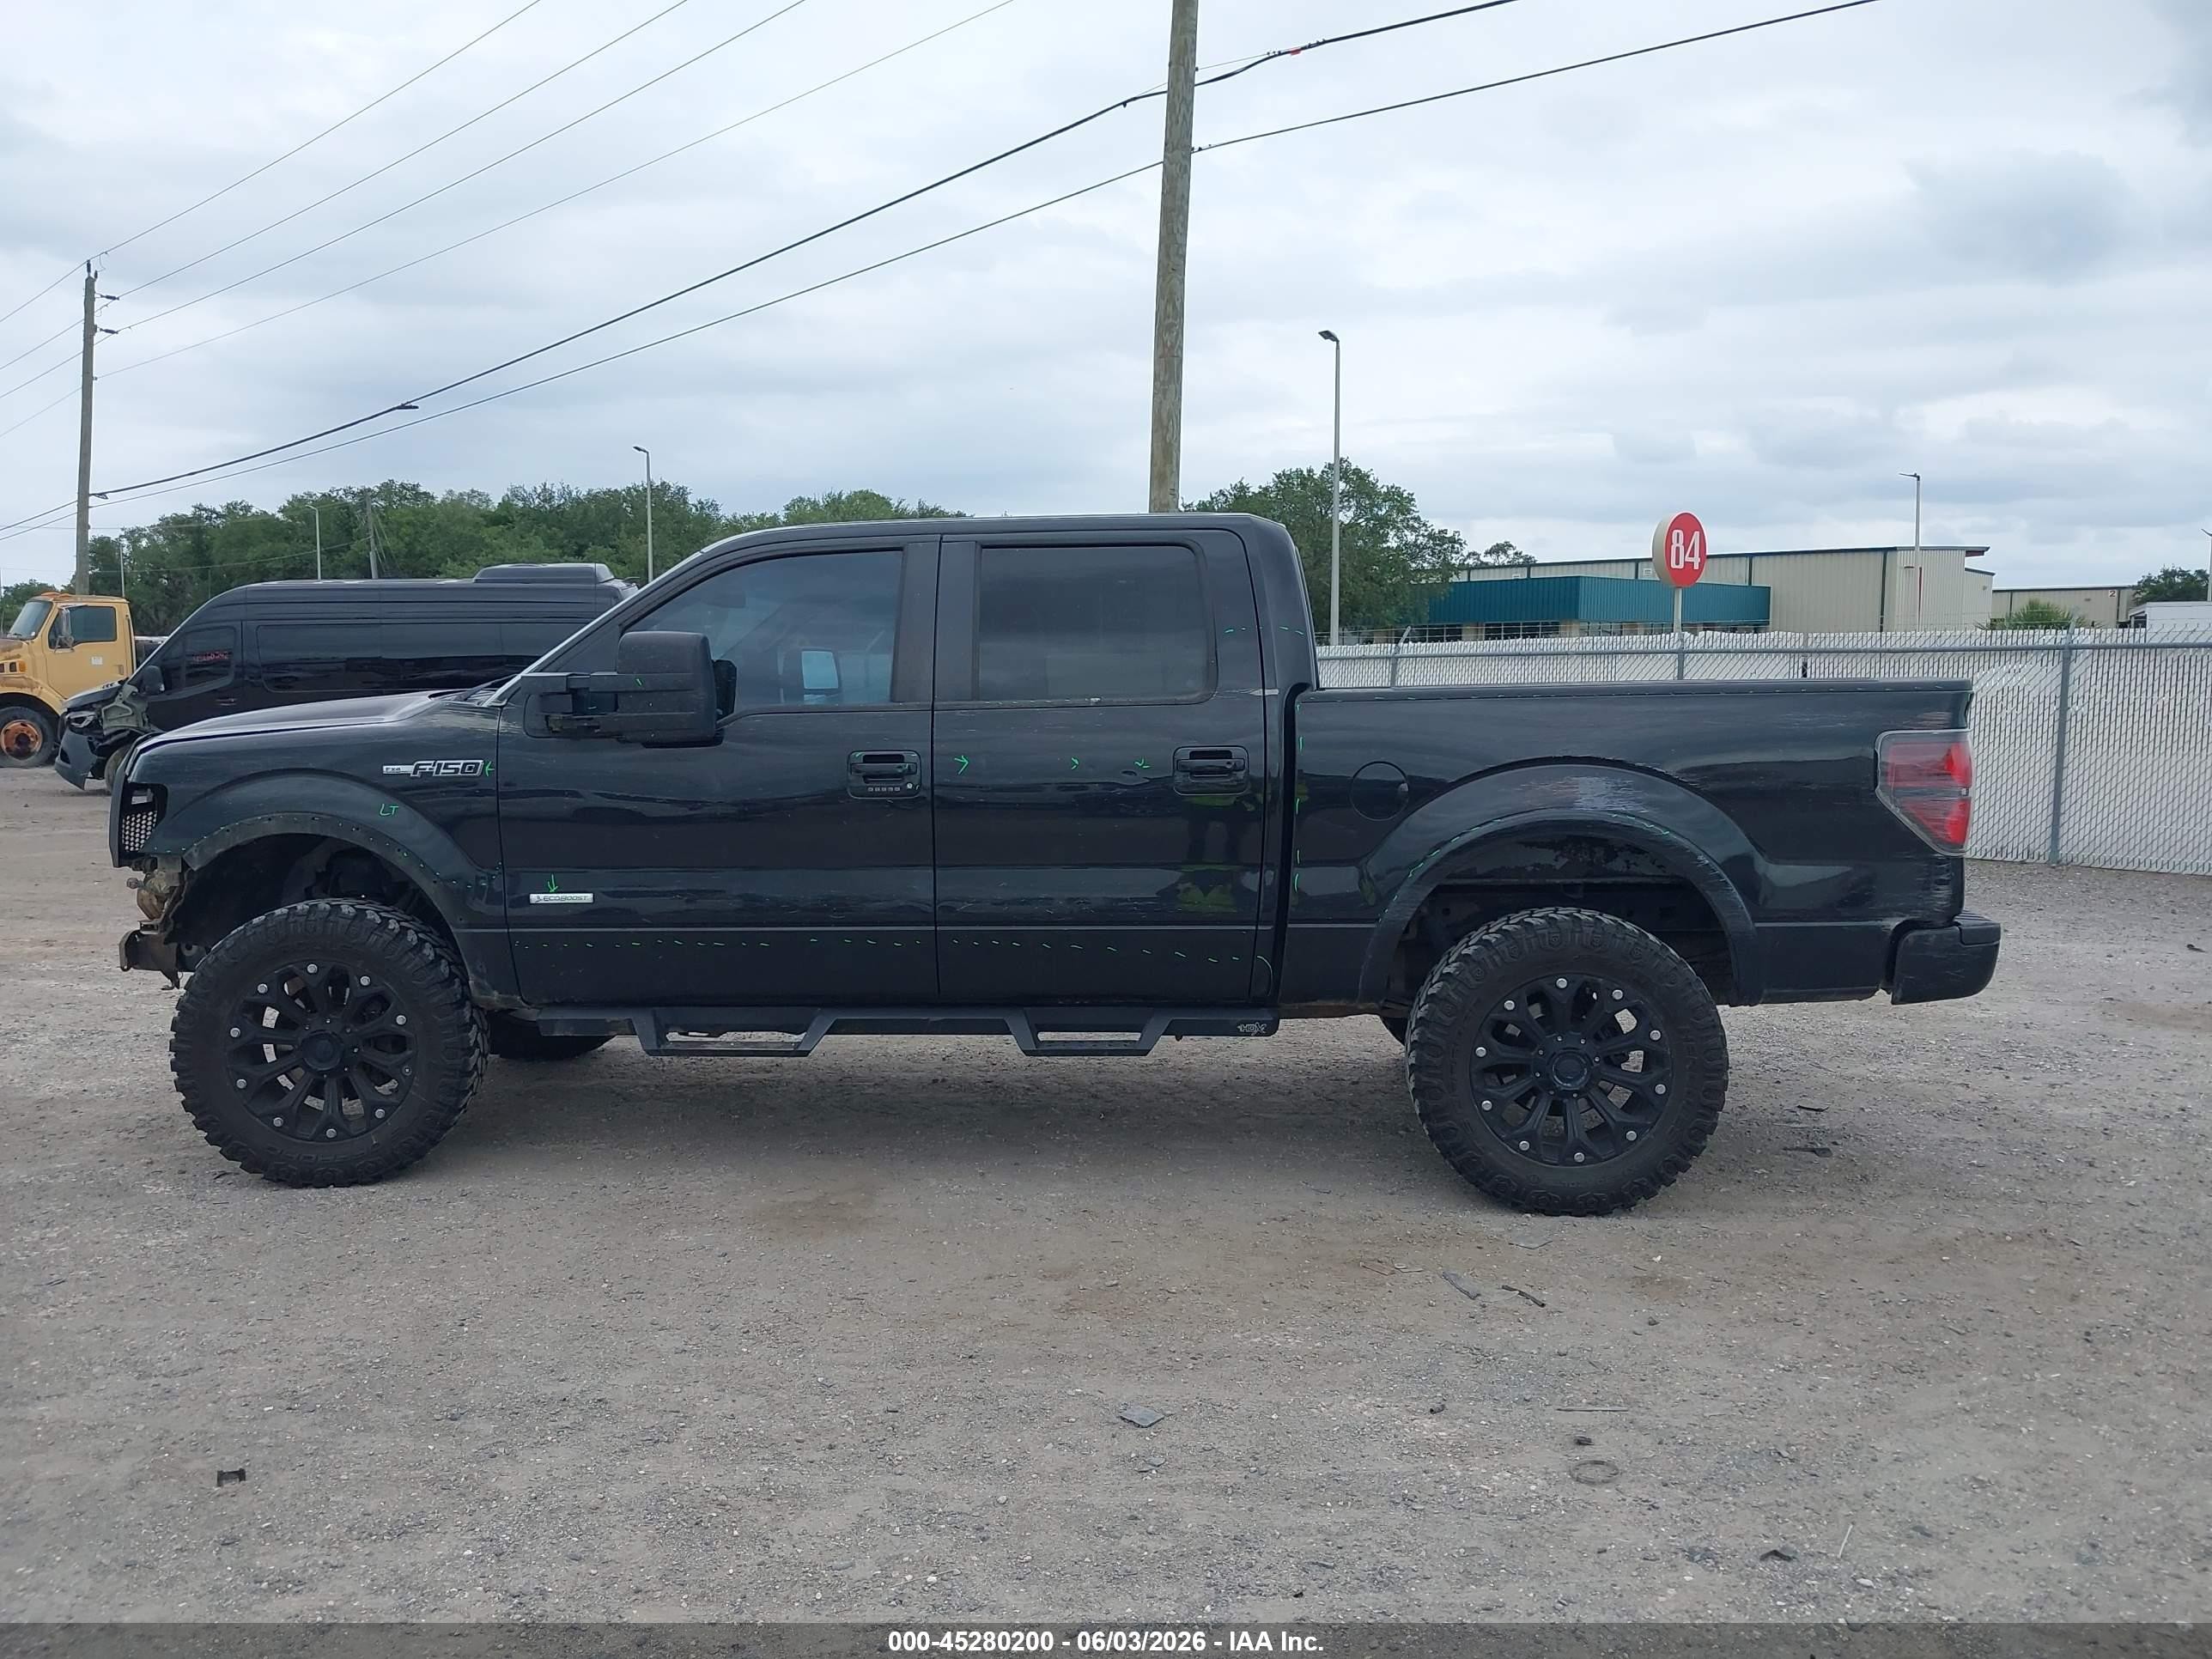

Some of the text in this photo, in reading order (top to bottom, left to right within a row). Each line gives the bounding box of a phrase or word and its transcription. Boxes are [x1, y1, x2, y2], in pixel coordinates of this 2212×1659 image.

[1670, 529, 1701, 570] 84
[410, 759, 485, 778] F-150
[380, 803, 399, 817] LT
